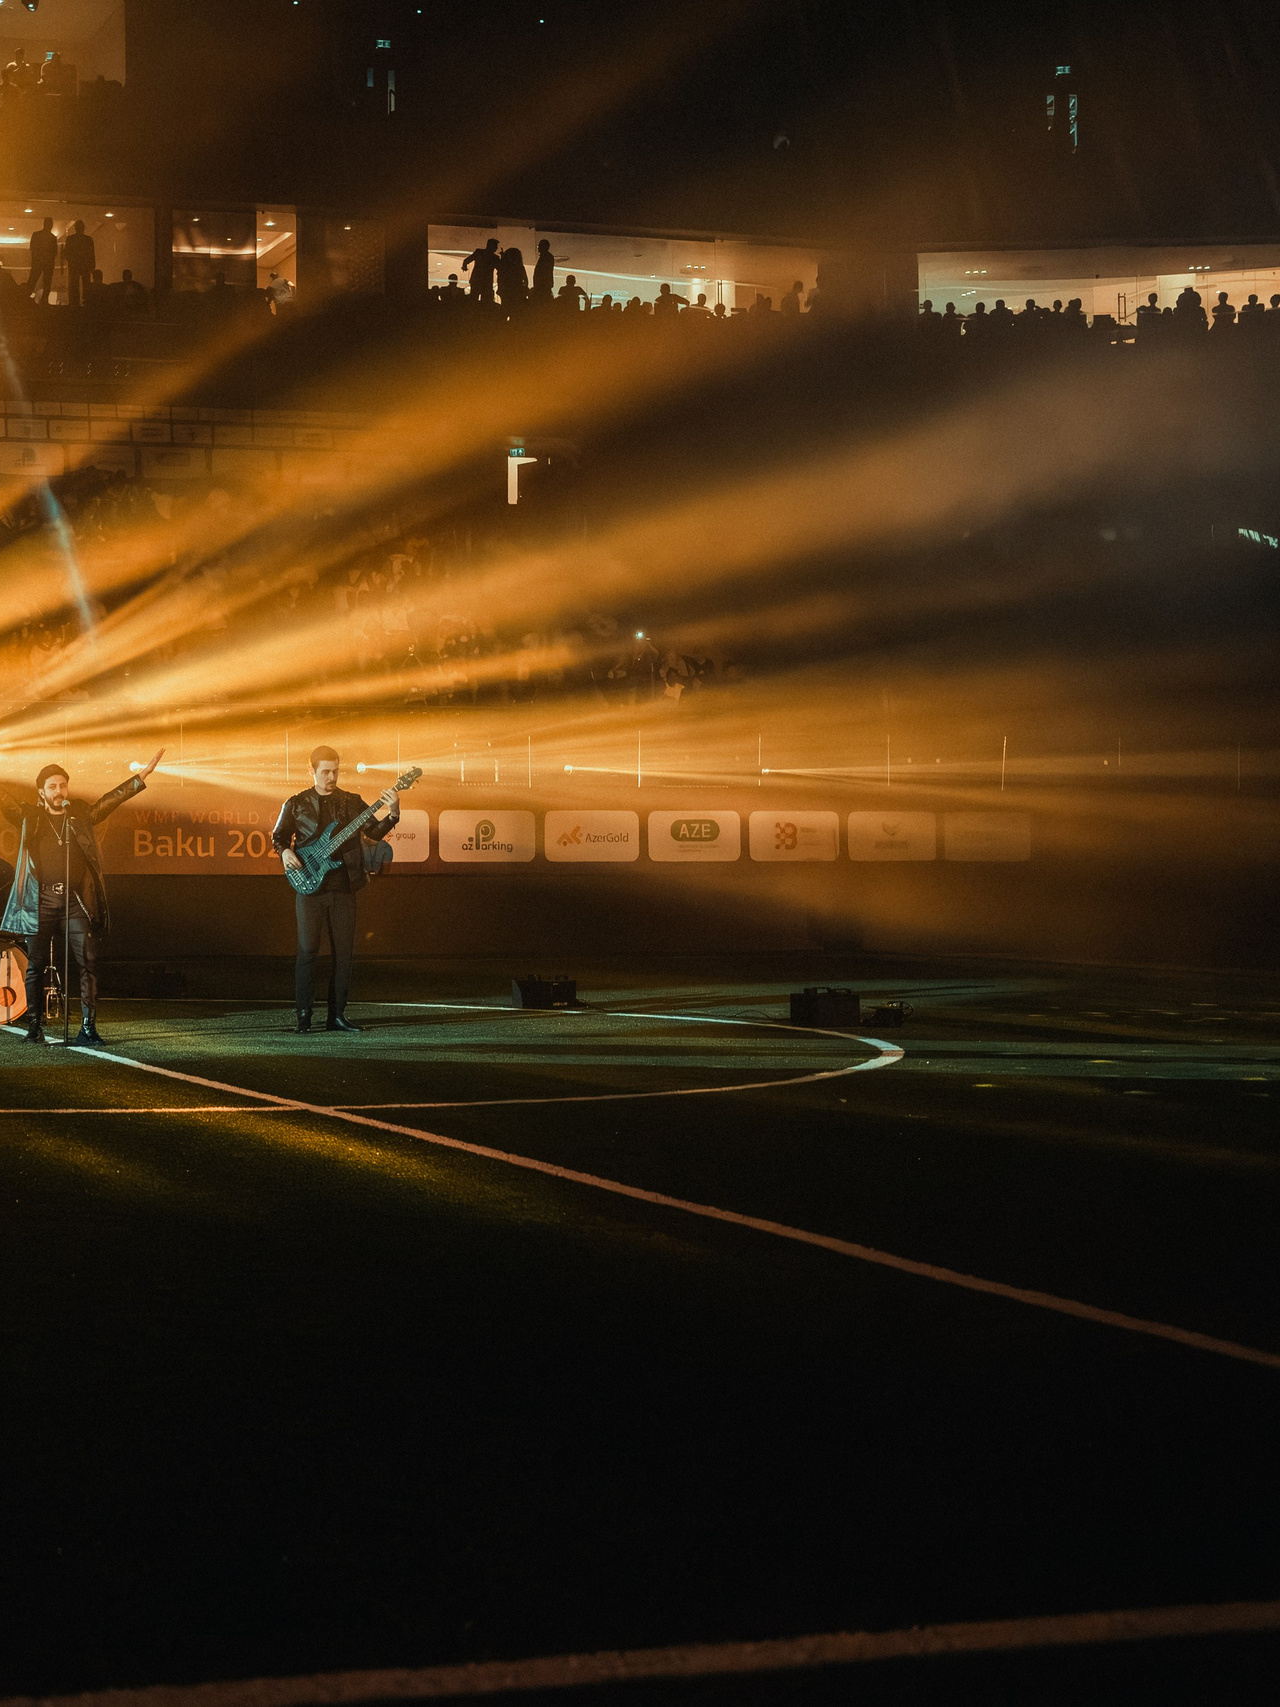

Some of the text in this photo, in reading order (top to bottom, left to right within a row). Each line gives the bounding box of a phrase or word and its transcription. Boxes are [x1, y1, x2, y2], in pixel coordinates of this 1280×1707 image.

[189, 810, 260, 825] WORLD
[395, 832, 417, 841] group
[585, 832, 629, 843] AzerGold
[679, 823, 711, 839] AZE
[134, 828, 215, 858] Baku
